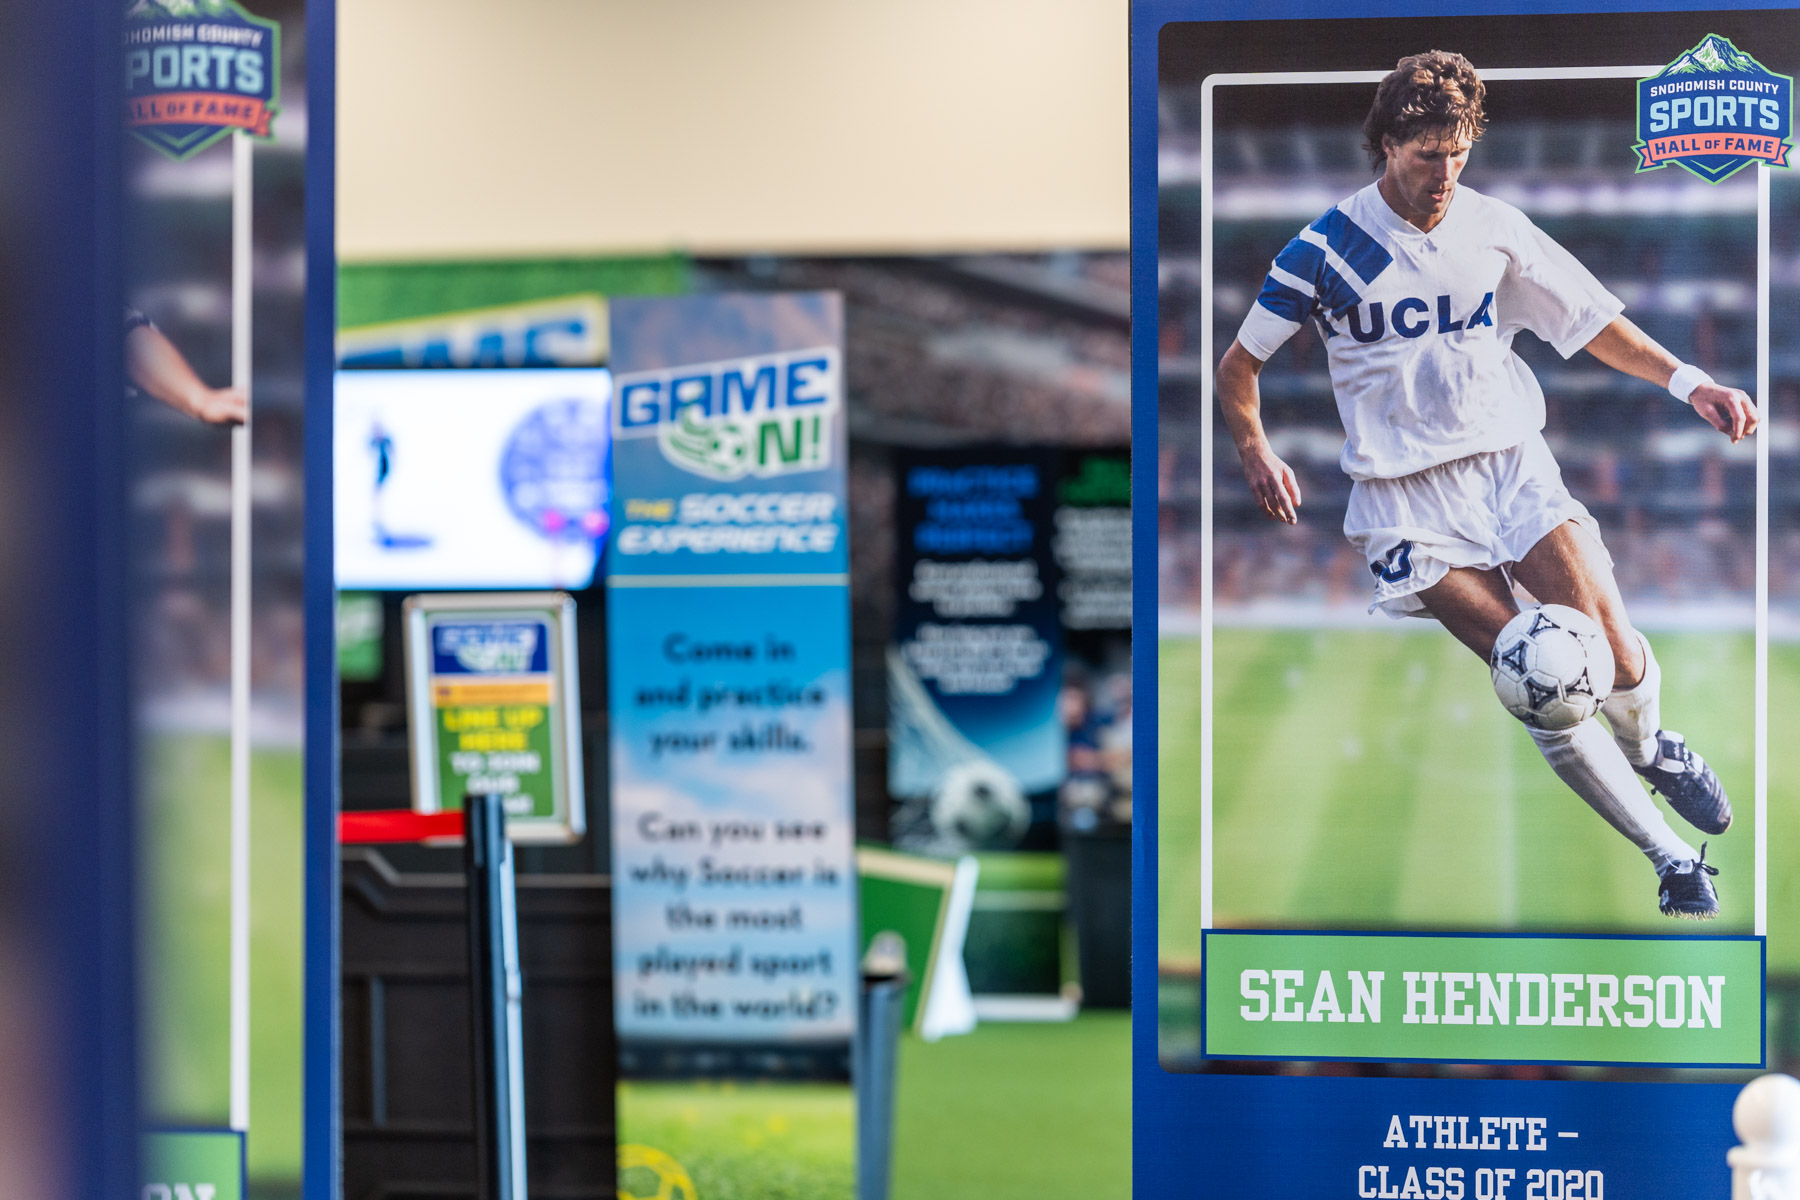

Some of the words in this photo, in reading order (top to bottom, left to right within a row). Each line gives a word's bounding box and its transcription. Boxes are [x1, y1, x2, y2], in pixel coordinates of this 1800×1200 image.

[124, 24, 195, 44] HOMISH
[125, 45, 264, 94] PORTS
[1650, 79, 1725, 97] SNOHOMISH
[1729, 80, 1779, 95] COUNTY
[192, 102, 254, 118] FAME
[1650, 96, 1780, 133] SPORTS
[1654, 138, 1700, 155] HALL
[1704, 140, 1720, 149] OF
[1724, 138, 1774, 154] FAME
[1347, 292, 1493, 343] UCLA
[621, 358, 828, 428] GAME
[624, 498, 674, 521] THE
[678, 493, 836, 523] SOCCER
[617, 524, 840, 555] EXPERIENCE
[663, 632, 756, 665] Come
[765, 635, 796, 663] in
[636, 681, 690, 708] and
[696, 681, 824, 716] practice
[648, 729, 716, 763] your
[727, 722, 813, 753] skills.
[637, 810, 699, 844] Can
[710, 820, 765, 851] you
[775, 819, 827, 843] see
[629, 857, 689, 893] why
[698, 857, 803, 887] Soccer
[813, 858, 840, 886] is
[665, 904, 717, 931] the
[725, 906, 804, 932] most
[636, 946, 742, 981] played
[750, 948, 833, 980] sport
[633, 991, 665, 1018] in
[671, 990, 723, 1020] the
[731, 990, 838, 1021] world?
[1240, 969, 1385, 1023] SEAN
[1402, 971, 1726, 1029] HENDERSON
[1384, 1114, 1547, 1151] ATHLETE
[1358, 1165, 1466, 1200] CLASS
[1475, 1167, 1515, 1200] OF
[1526, 1169, 1604, 1200] 2020
